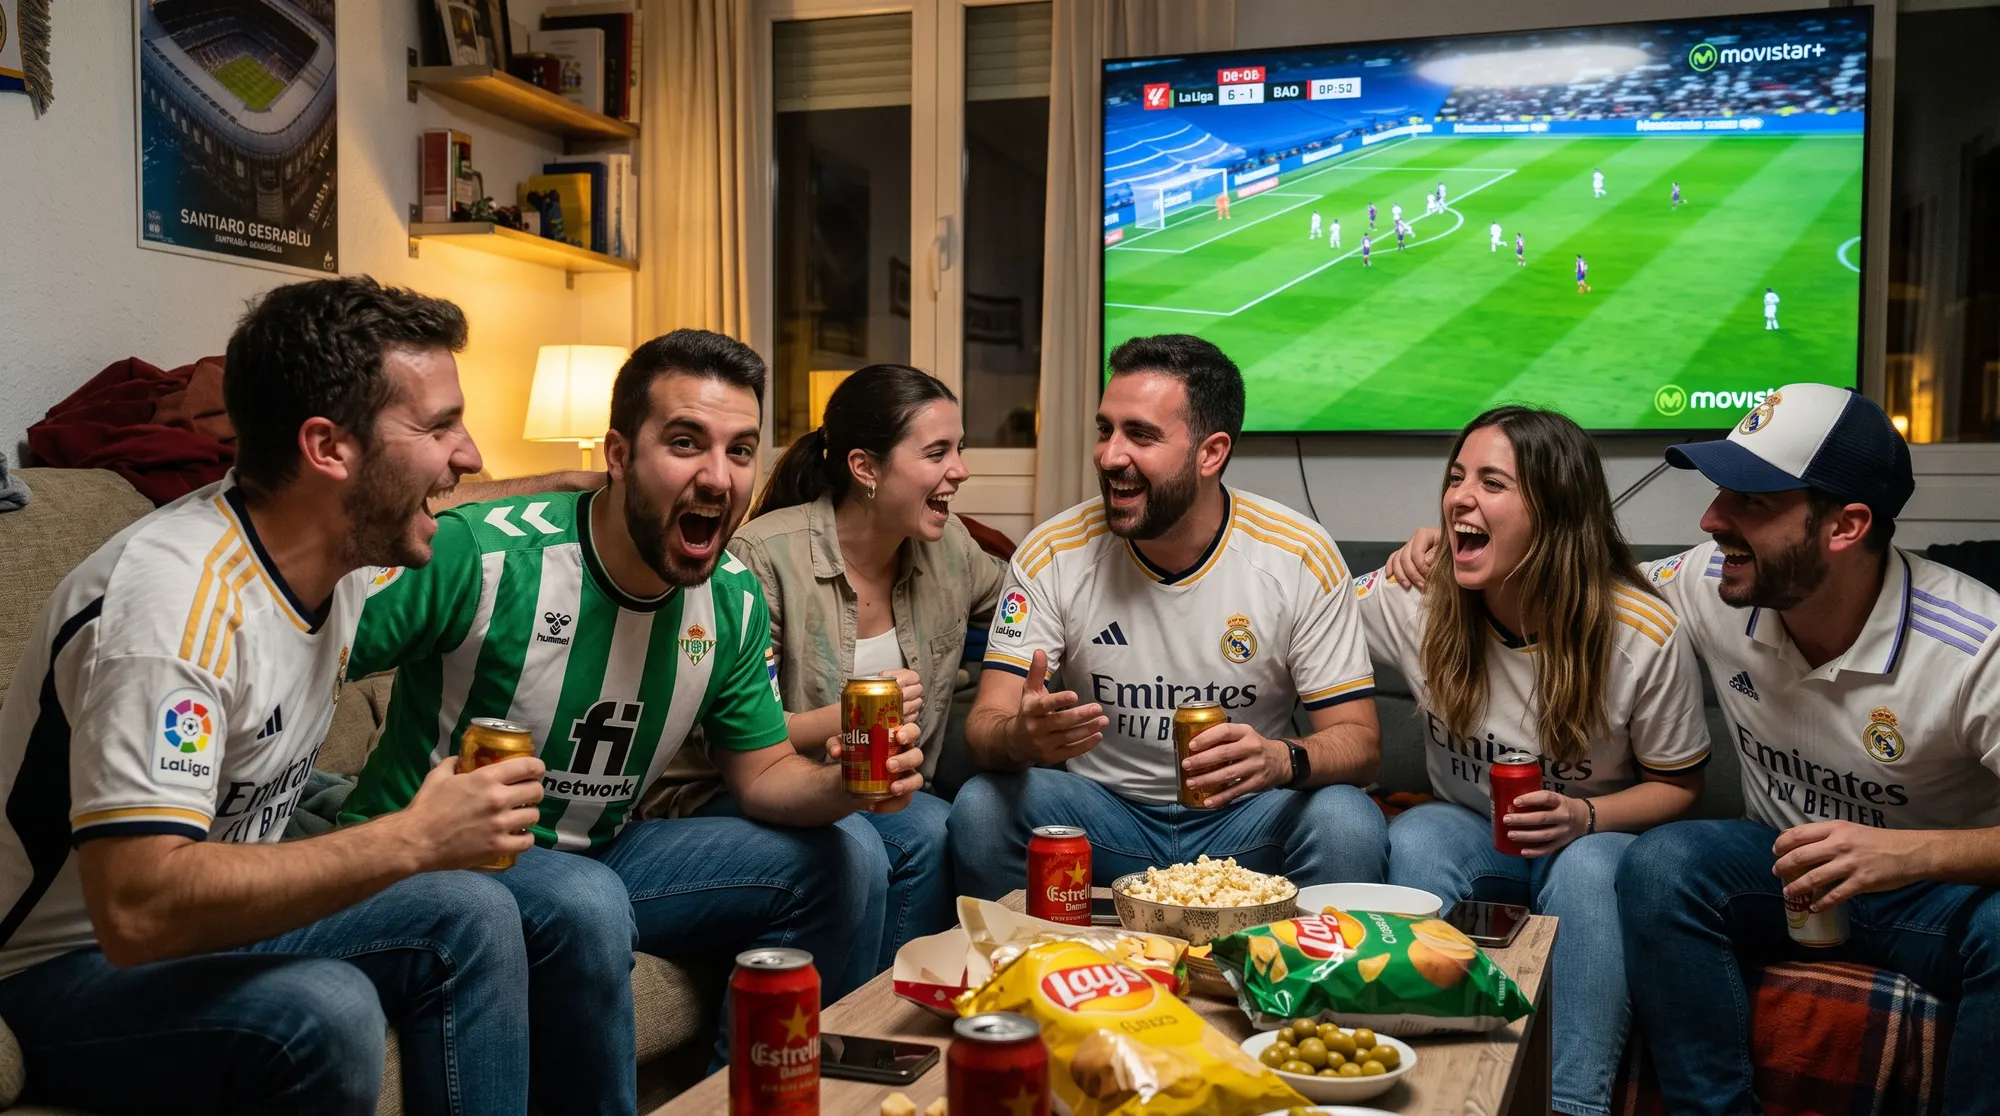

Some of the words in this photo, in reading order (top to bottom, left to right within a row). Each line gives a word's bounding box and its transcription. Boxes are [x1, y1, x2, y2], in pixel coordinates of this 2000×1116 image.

[1720, 43, 1826, 64] movistar+
[1178, 91, 1214, 104] LaLiga
[1228, 89, 1235, 101] 6
[1249, 88, 1254, 99] 1
[180, 208, 245, 235] SANTIARO
[248, 222, 311, 248] GESRABLU
[536, 632, 570, 646] hummel
[1091, 672, 1257, 710] Emirates
[572, 700, 641, 777] fi
[1117, 714, 1152, 738] FLY
[160, 757, 210, 777] LaLiga
[1451, 757, 1482, 785] FLY
[1735, 722, 1909, 807] Emirates
[215, 741, 325, 818] Emirat
[542, 776, 634, 798] network
[1766, 772, 1796, 805] FLY
